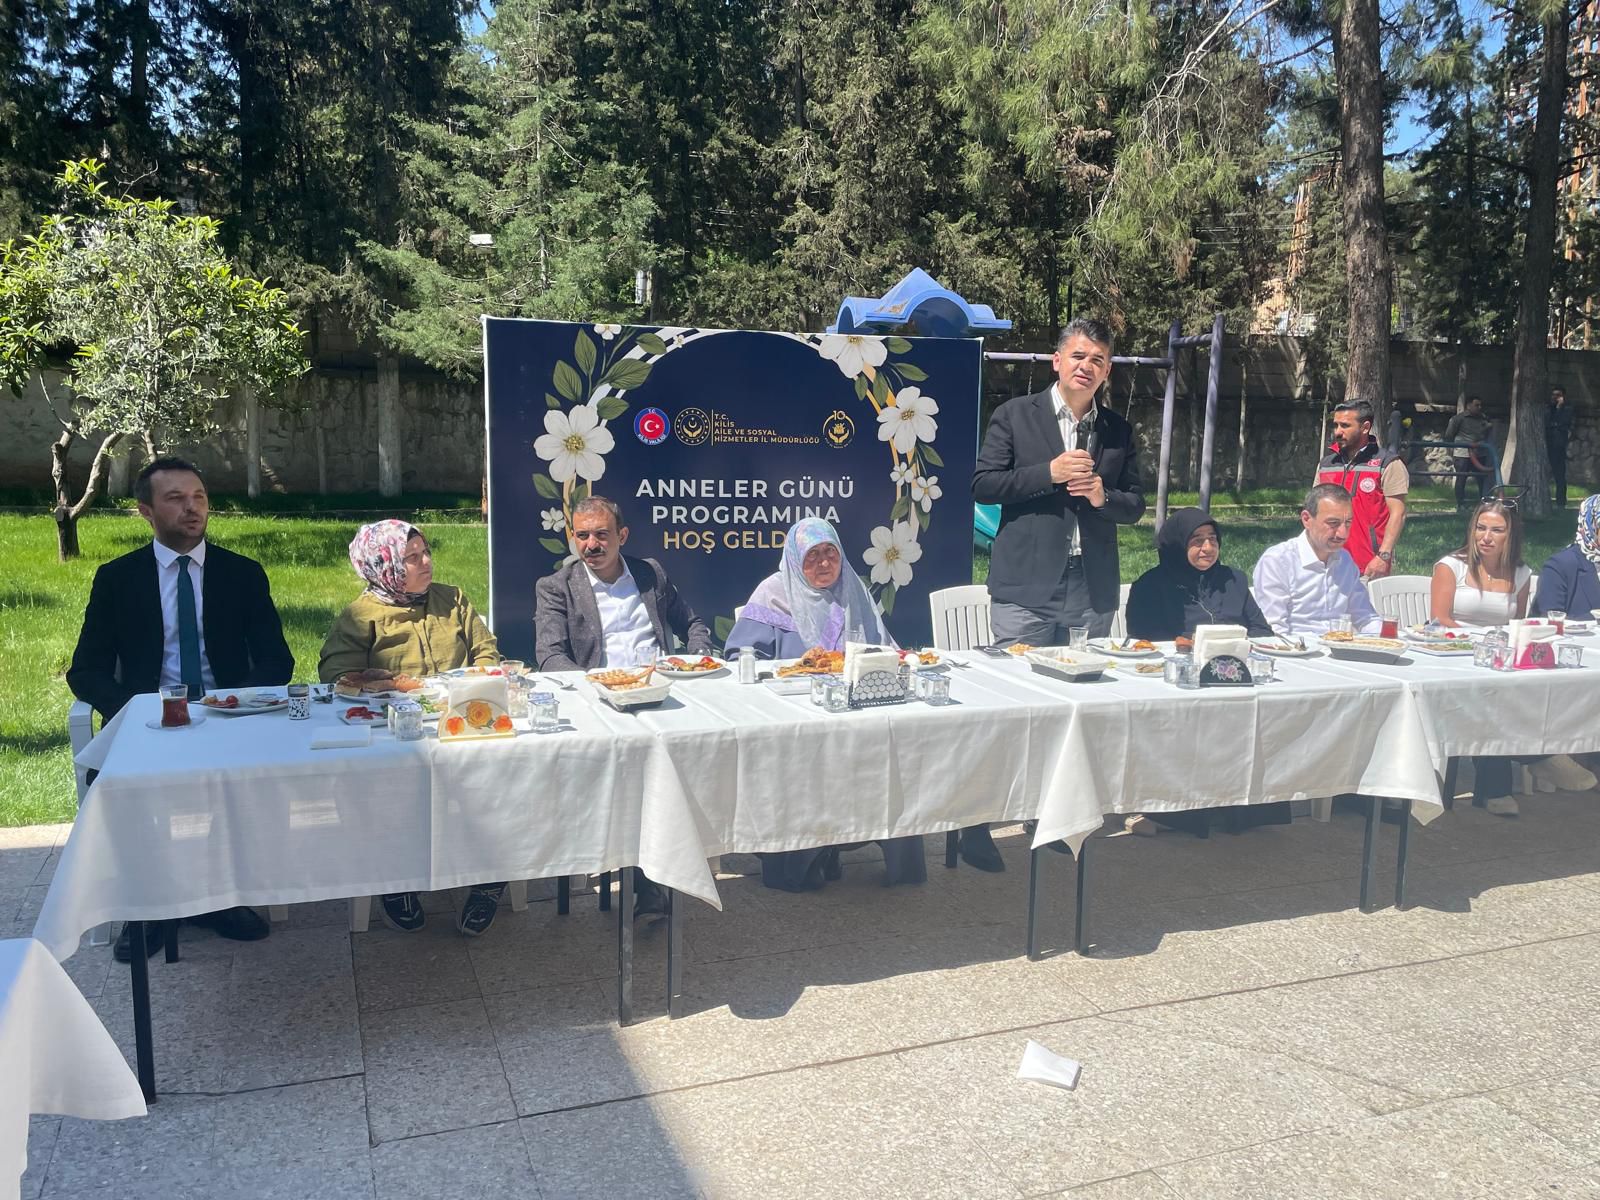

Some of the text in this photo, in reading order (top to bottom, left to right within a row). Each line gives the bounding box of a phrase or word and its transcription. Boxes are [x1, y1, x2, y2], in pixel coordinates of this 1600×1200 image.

[832, 410, 846, 420] 10
[714, 419, 735, 428] KİLİS
[714, 427, 732, 435] AİLE
[714, 434, 759, 443] HİZMETLER
[760, 435, 769, 443] İL
[770, 435, 820, 444] MÜDÜRLÜĞÜ
[635, 475, 854, 498] ANNELER GÜNÜ
[652, 505, 841, 524] PROGRAMINA
[663, 530, 787, 554] HOŞ GELD
